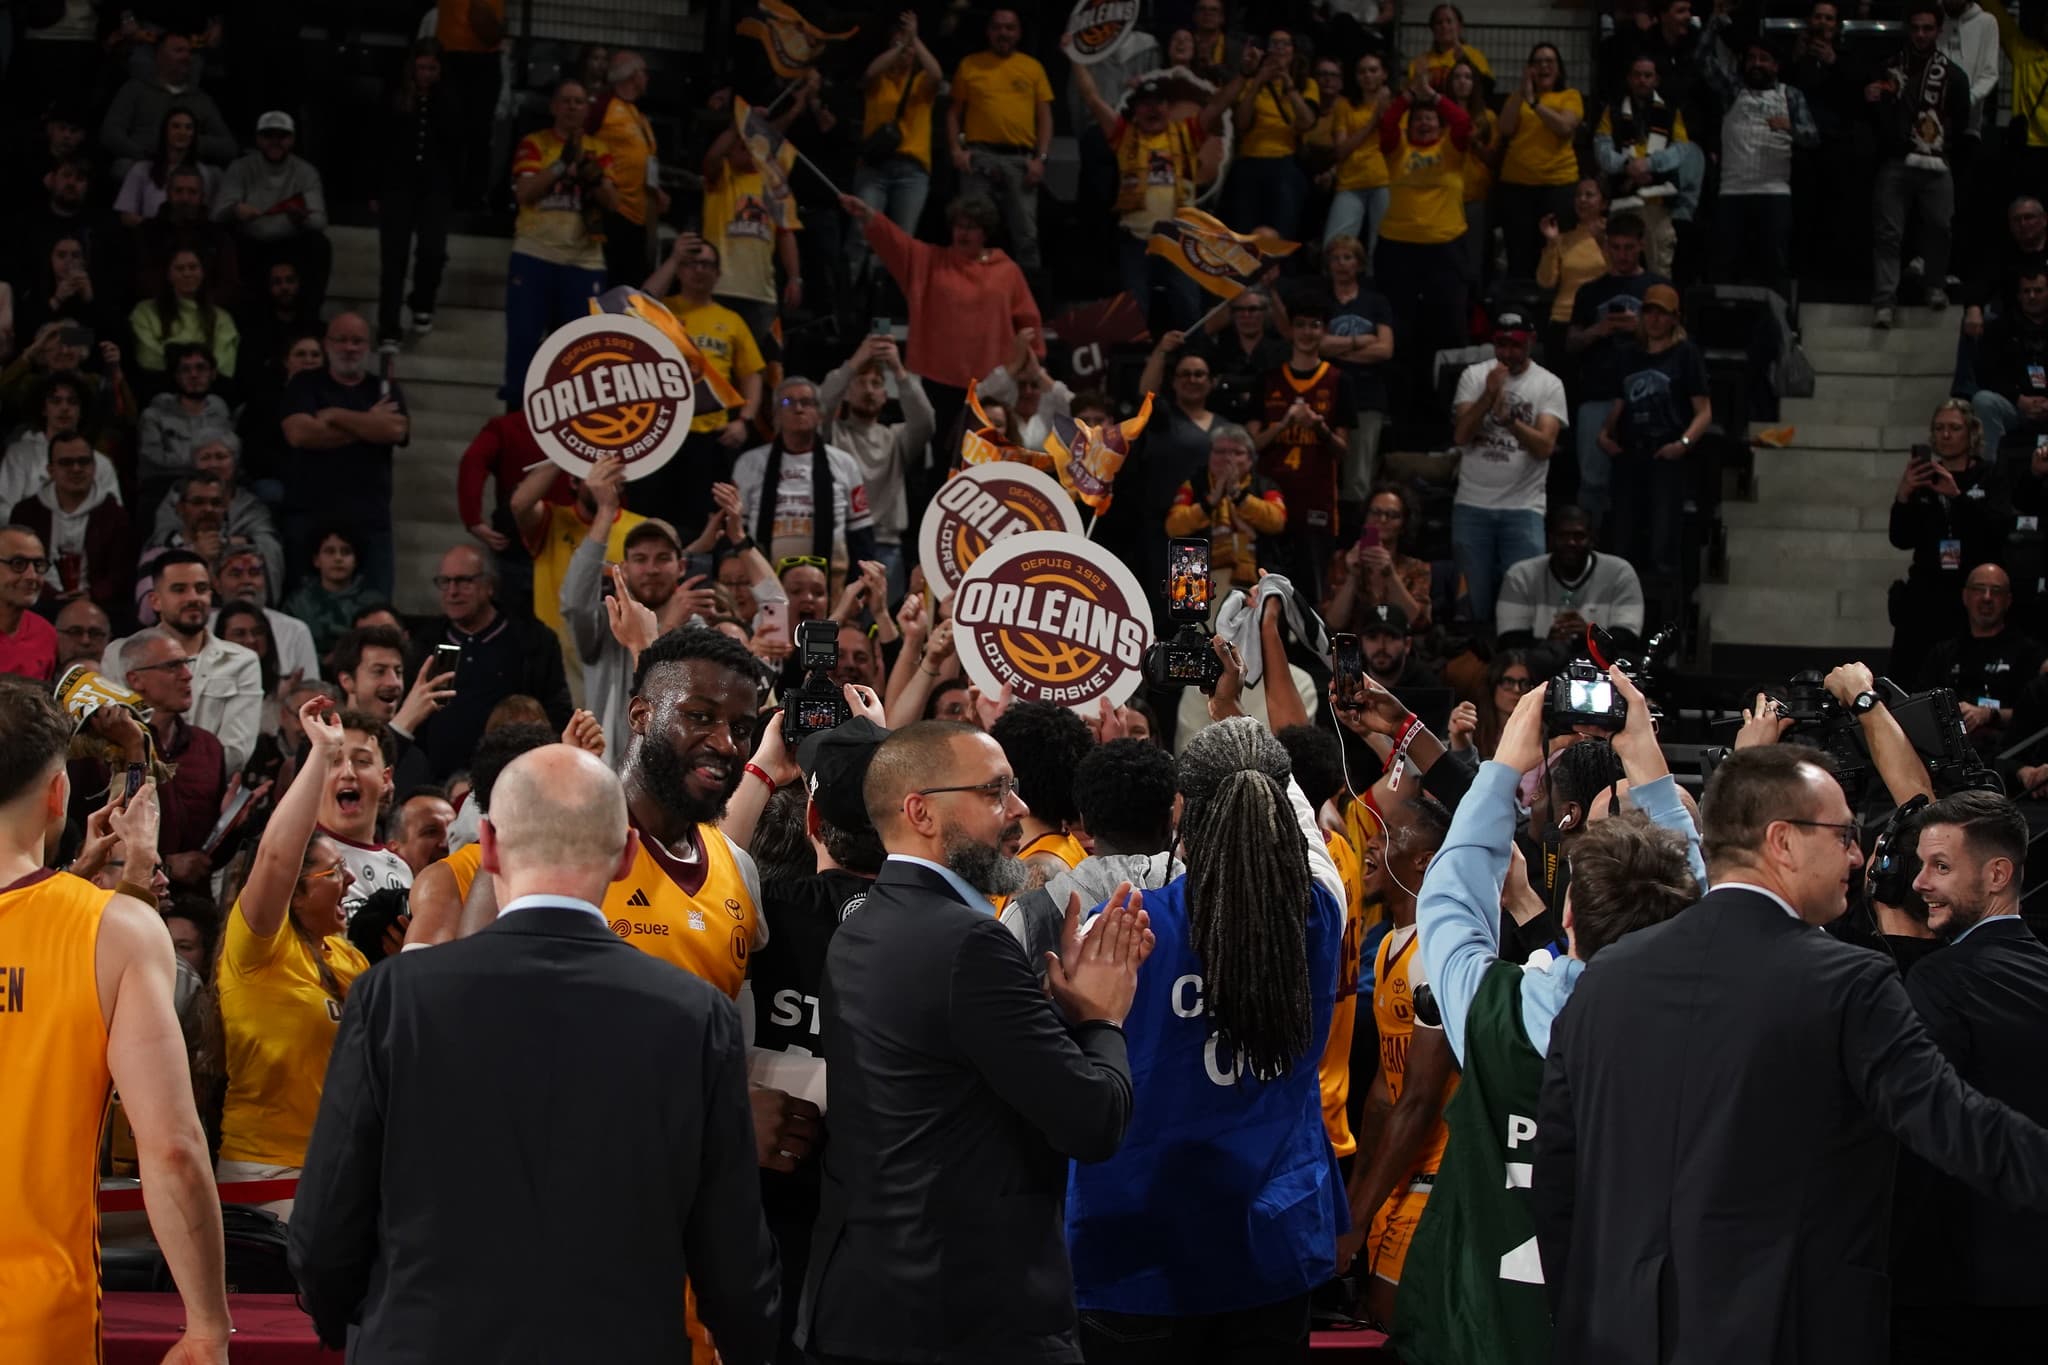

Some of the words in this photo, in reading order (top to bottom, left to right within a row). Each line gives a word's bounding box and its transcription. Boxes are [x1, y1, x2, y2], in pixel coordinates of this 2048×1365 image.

[561, 338, 602, 367] DEPUIS
[531, 361, 688, 431] ORLÉANS
[559, 427, 619, 460] LOIRET
[622, 405, 672, 460] BASKET
[1008, 487, 1049, 513] DEPUIS
[941, 519, 962, 581] LOIRET
[1020, 558, 1072, 572] DEPUIS
[1075, 565, 1108, 592] 1993
[960, 581, 1143, 668] ORLÉANS
[980, 632, 1036, 694] LOIRET
[1039, 663, 1115, 701] BASKET
[1547, 853, 1557, 889] Nikon
